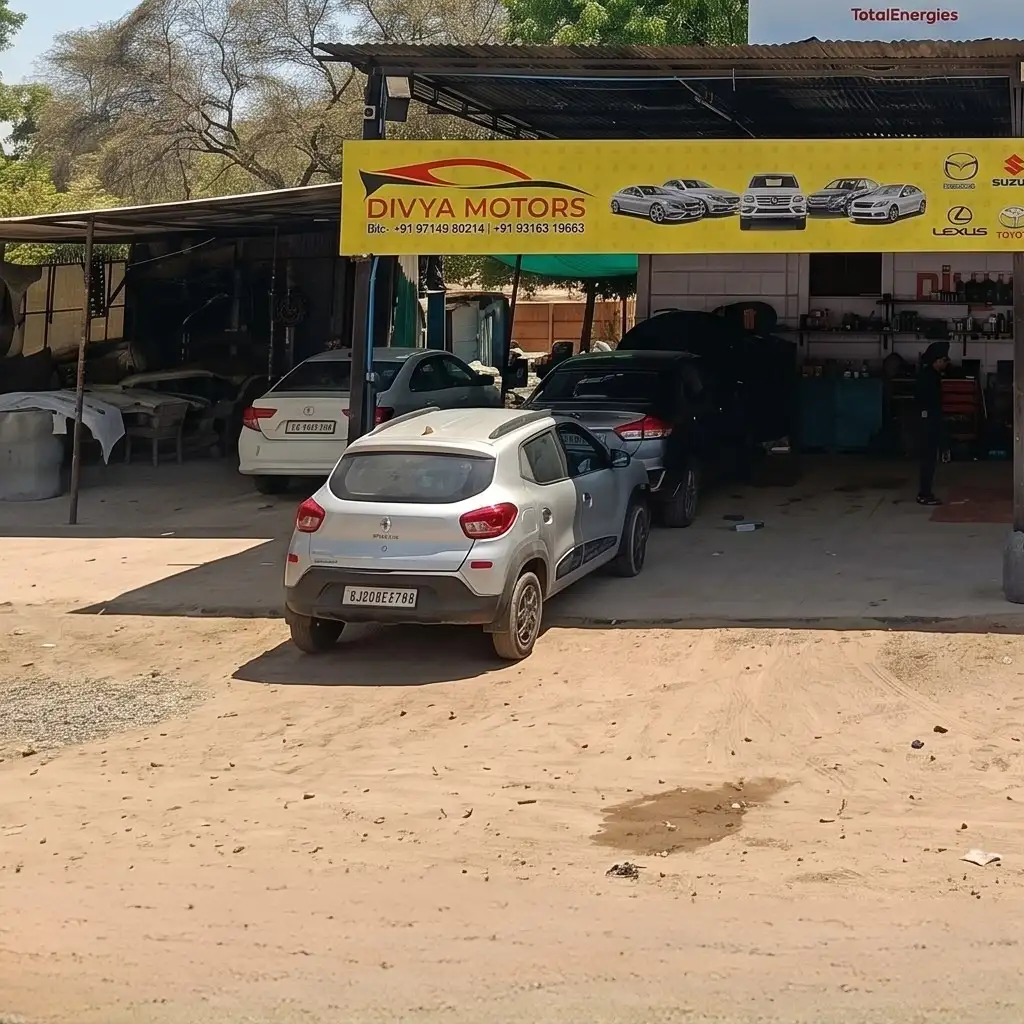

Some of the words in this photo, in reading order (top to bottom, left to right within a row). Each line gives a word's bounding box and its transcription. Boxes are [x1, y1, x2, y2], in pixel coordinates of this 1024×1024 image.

[851, 7, 959, 24] TotalEnergies
[367, 198, 456, 219] DIVYA
[464, 197, 586, 218] MOTORS
[394, 223, 412, 234] +91
[416, 223, 449, 234] 97149
[451, 223, 485, 234] 80214
[493, 223, 512, 233] +91
[516, 223, 549, 233] 93163
[552, 223, 585, 233] 19663
[932, 227, 988, 236] LEXUS
